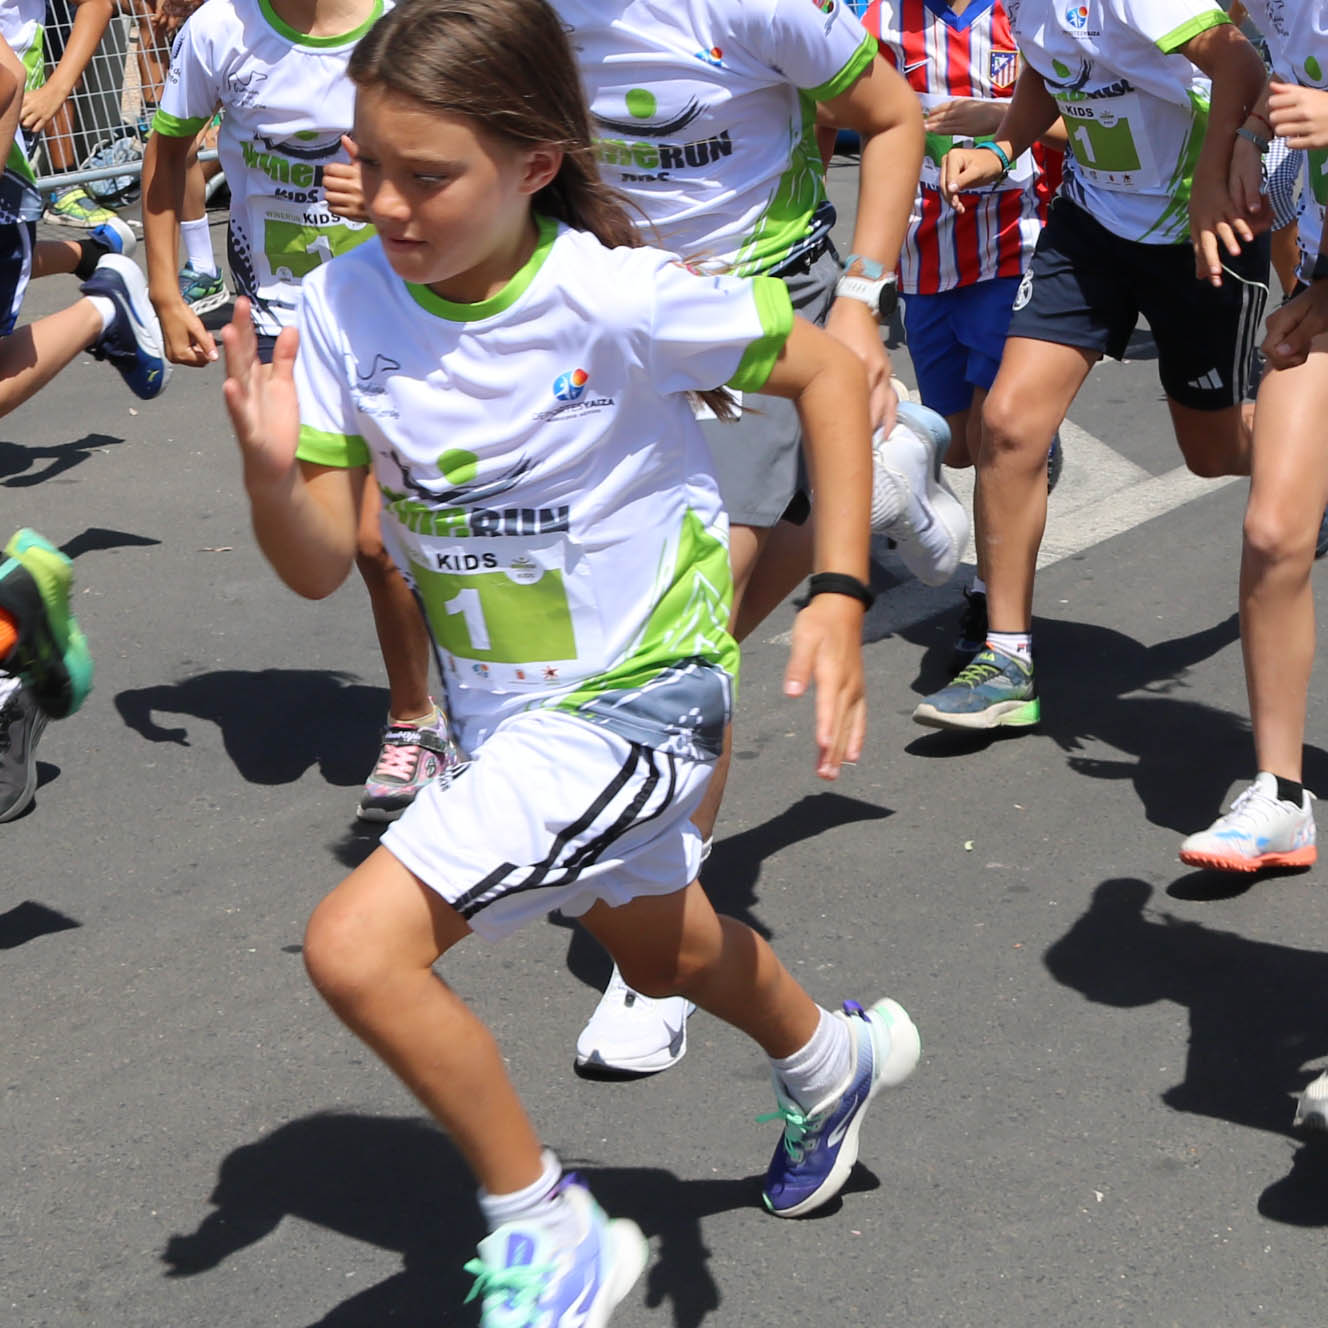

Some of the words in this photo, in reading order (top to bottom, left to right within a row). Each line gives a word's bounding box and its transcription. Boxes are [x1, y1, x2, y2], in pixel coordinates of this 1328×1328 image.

[1066, 105, 1094, 118] KIDS
[1074, 125, 1097, 164] 1
[303, 212, 341, 225] KIDS
[437, 552, 498, 571] KIDS
[444, 588, 492, 651] 1
